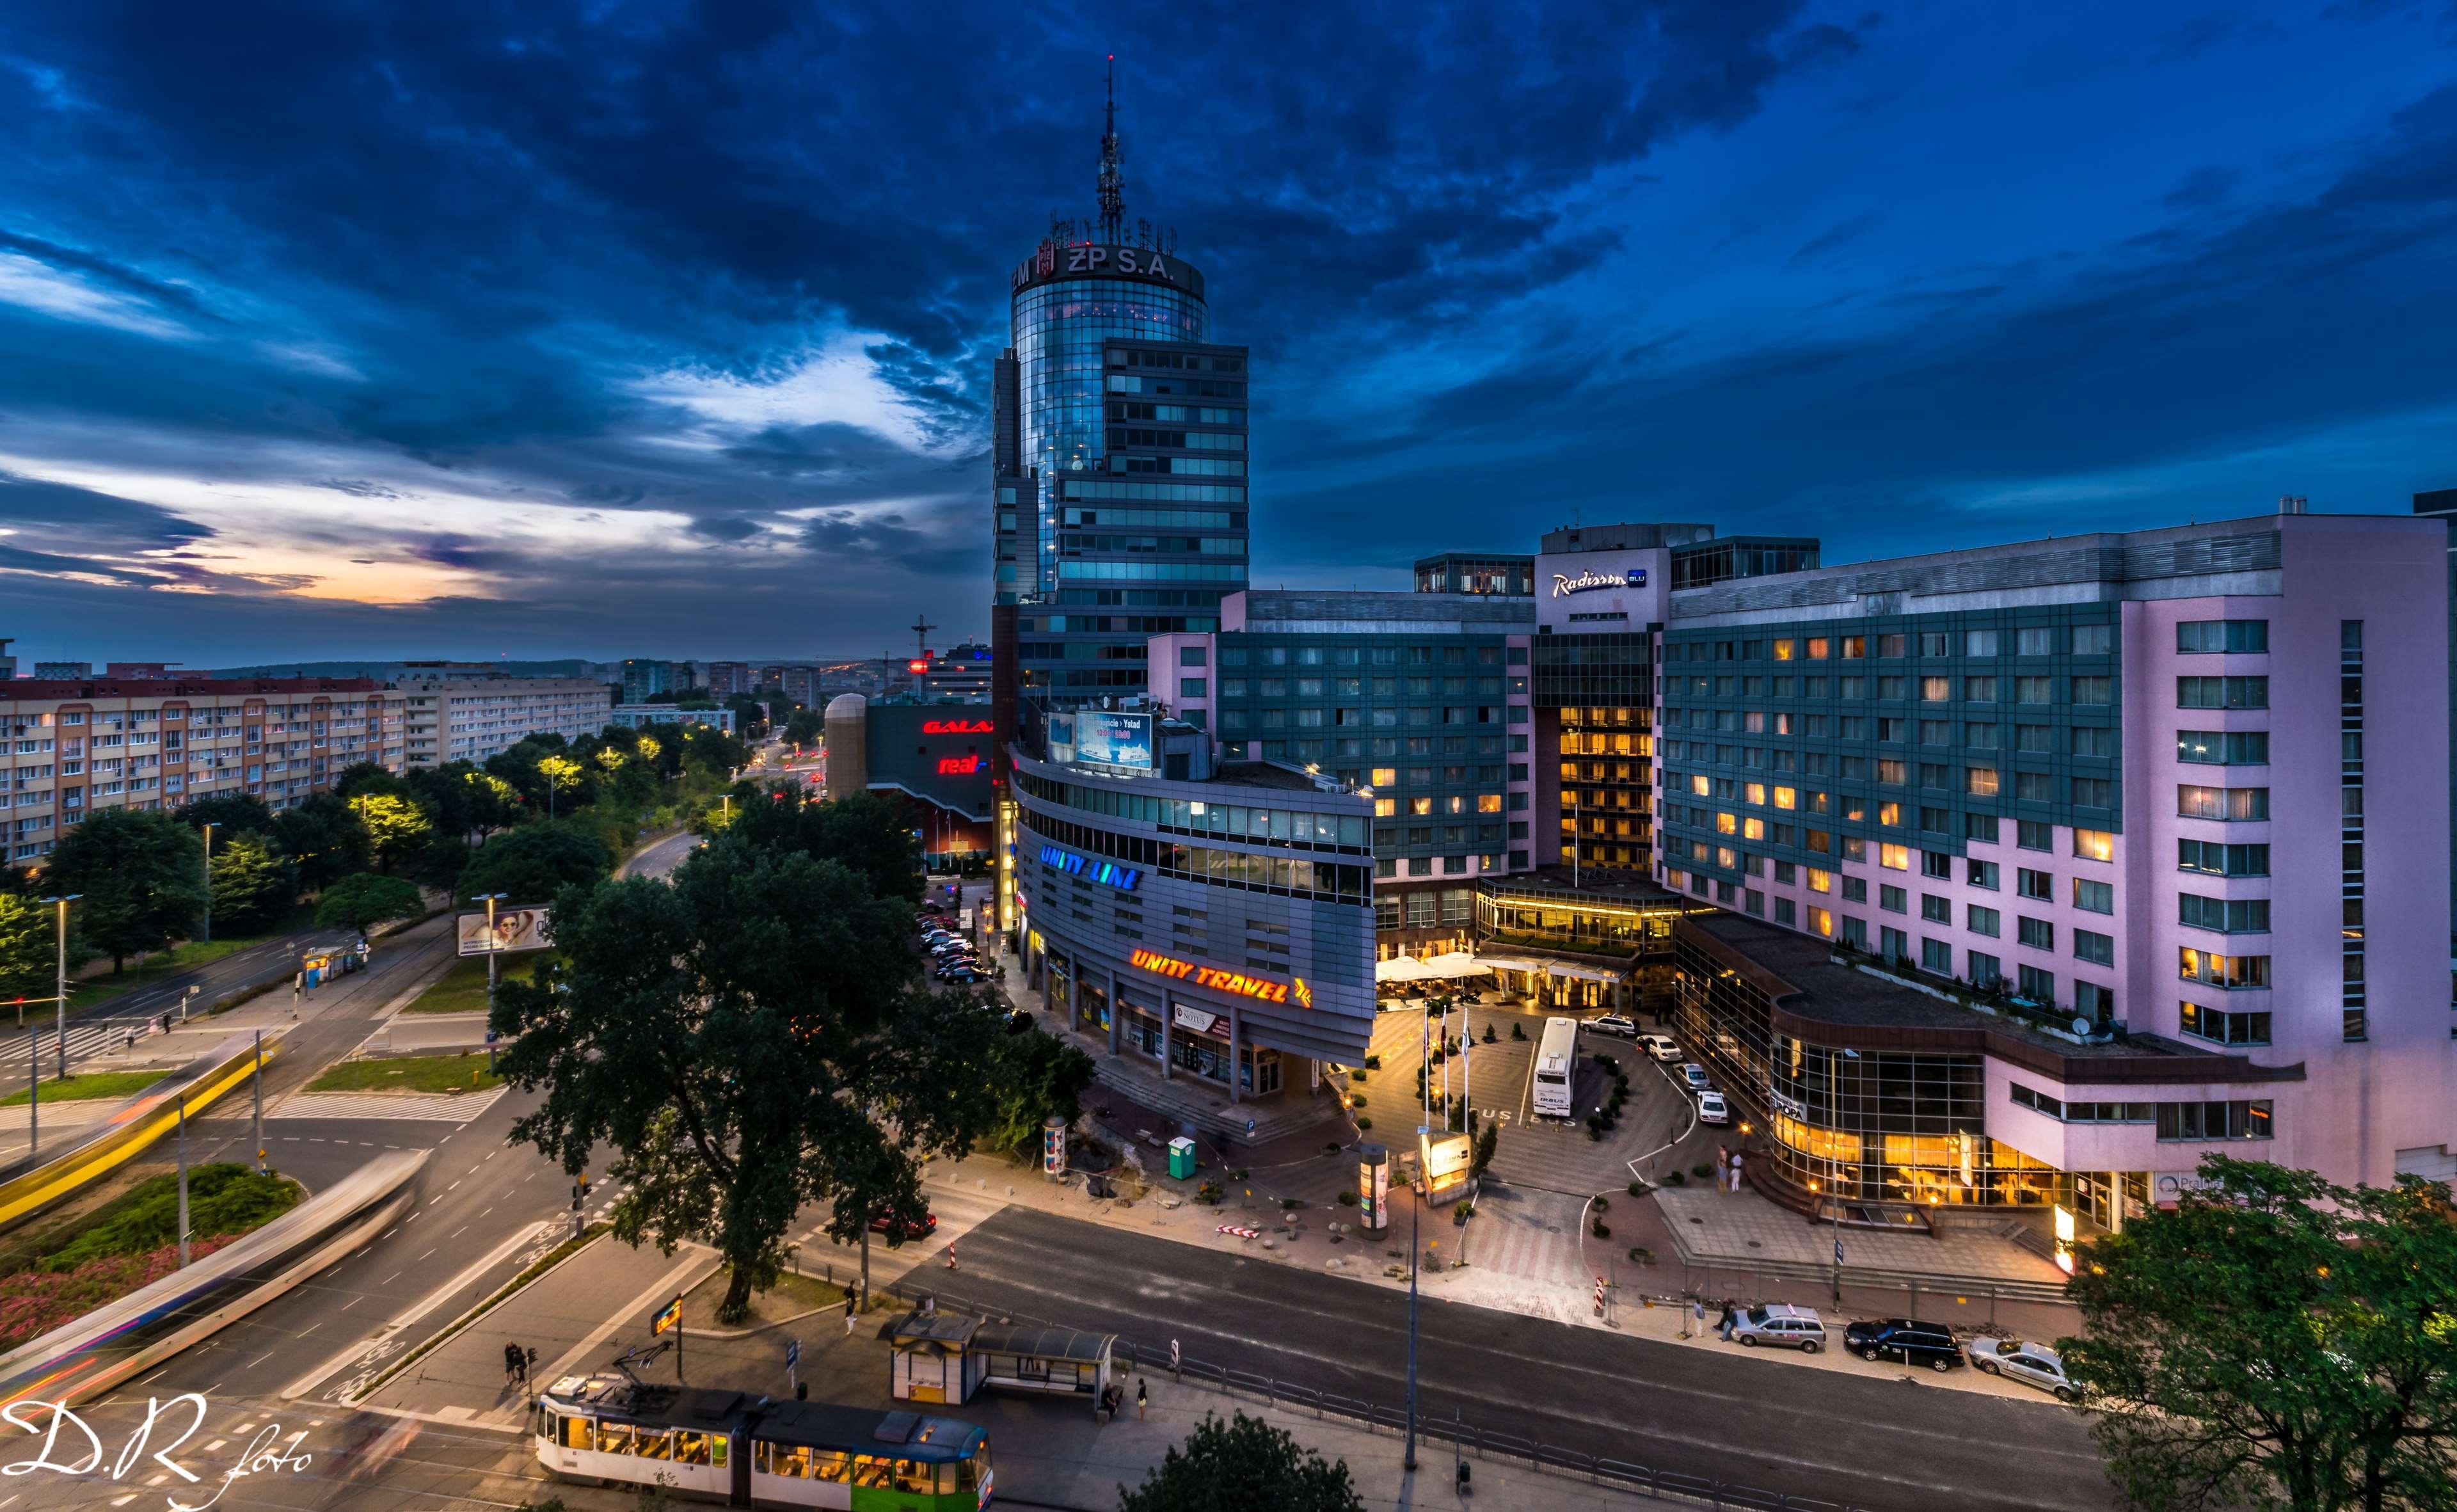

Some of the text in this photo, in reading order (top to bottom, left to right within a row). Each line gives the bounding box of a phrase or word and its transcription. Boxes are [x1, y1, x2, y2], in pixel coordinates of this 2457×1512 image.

[1118, 249, 1173, 281] S.A.
[1553, 571, 1626, 598] Radisson
[1124, 719, 1140, 728] Ystad
[1041, 845, 1141, 890] UNITY LINE
[1131, 949, 1289, 1003] UNITY TRAVEL
[1184, 1013, 1205, 1024] NOTUS
